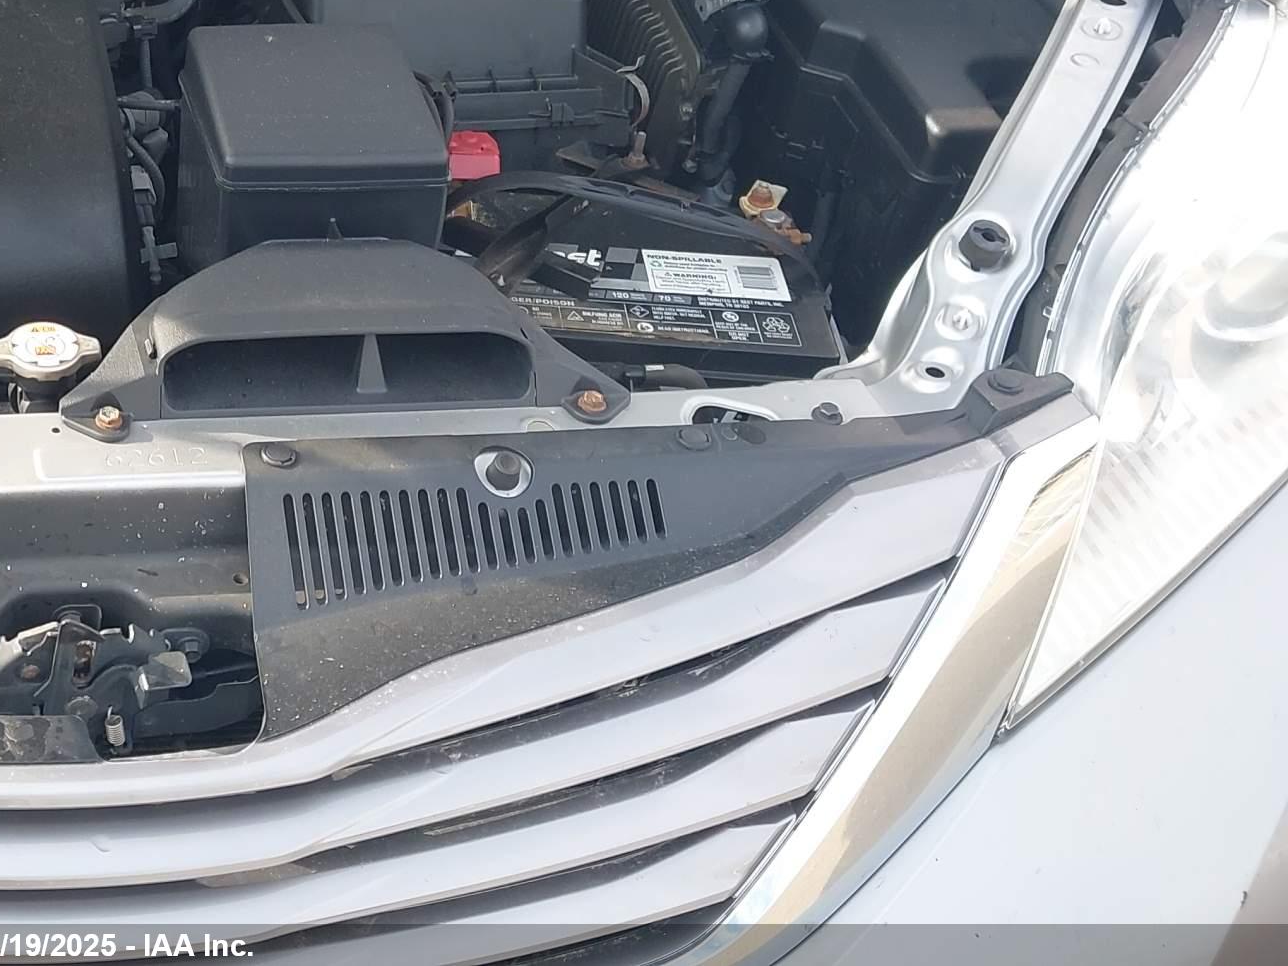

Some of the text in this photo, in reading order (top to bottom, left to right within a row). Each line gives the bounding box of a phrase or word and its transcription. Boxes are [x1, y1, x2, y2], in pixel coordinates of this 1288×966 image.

[646, 254, 722, 264] NON-SPILLABLE
[612, 291, 629, 299] 120
[511, 296, 575, 307] GER/POISON
